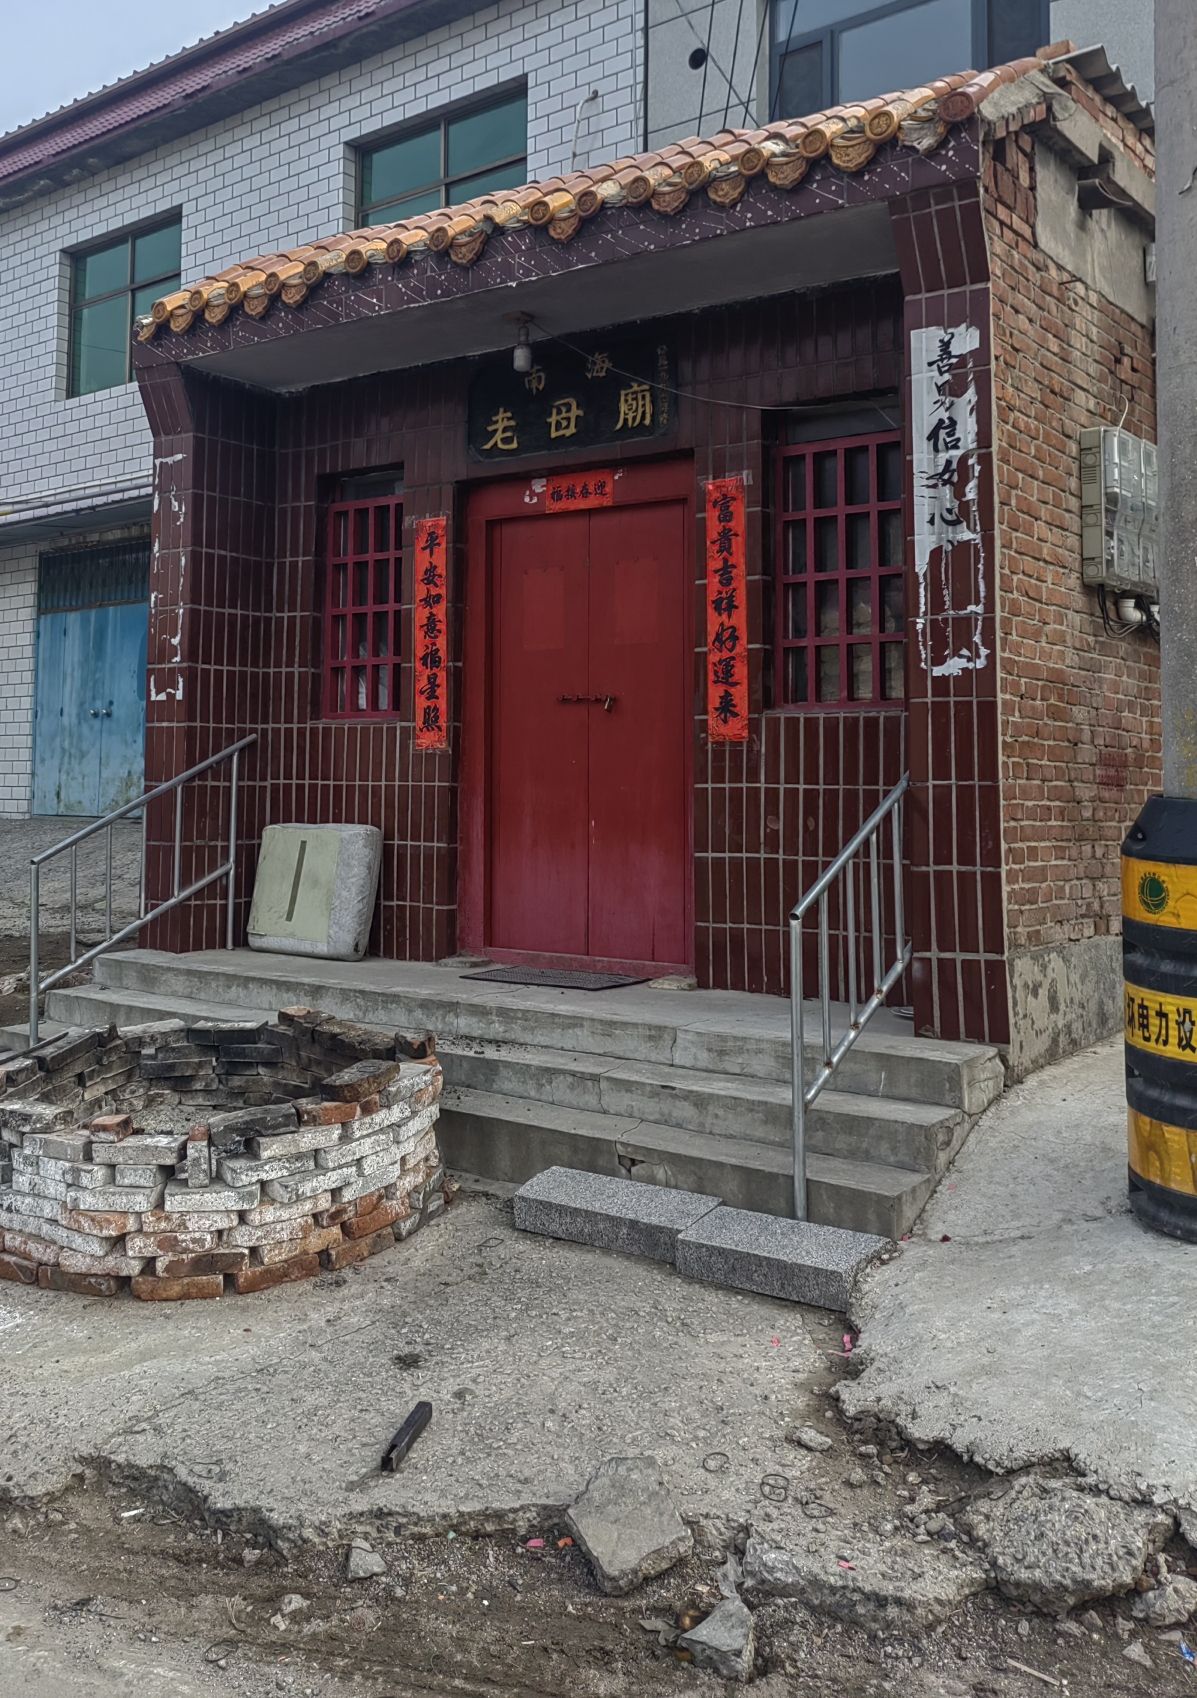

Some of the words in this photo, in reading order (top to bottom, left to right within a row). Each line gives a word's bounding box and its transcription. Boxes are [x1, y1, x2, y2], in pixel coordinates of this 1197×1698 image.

[419, 530, 443, 733] 平安如意福星照
